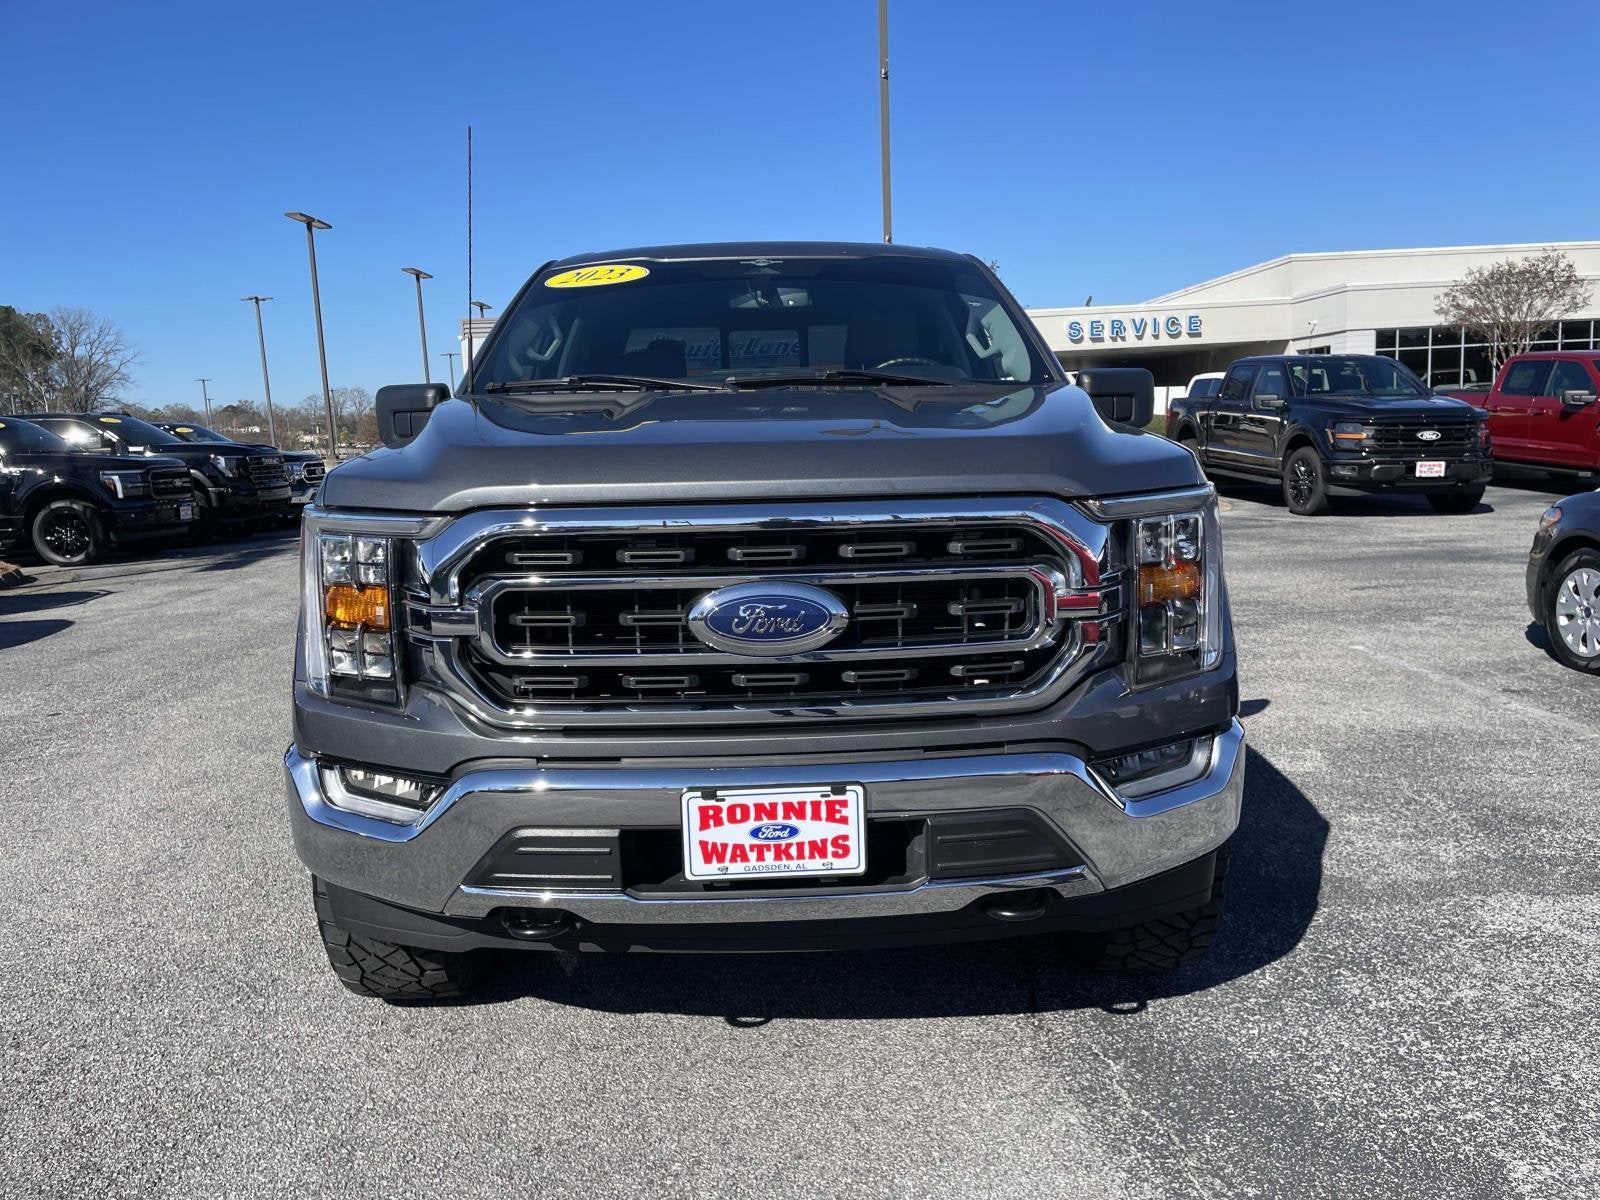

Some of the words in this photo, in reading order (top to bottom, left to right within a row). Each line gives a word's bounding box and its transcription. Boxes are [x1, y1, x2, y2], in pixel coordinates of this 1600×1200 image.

[558, 268, 632, 284] 2023
[1068, 315, 1202, 341] SERVICE
[731, 603, 806, 634] Ford
[698, 799, 849, 831] RONNIE
[757, 825, 790, 840] Ford
[699, 834, 851, 864] WATKINS
[743, 863, 792, 872] GADSDEN,
